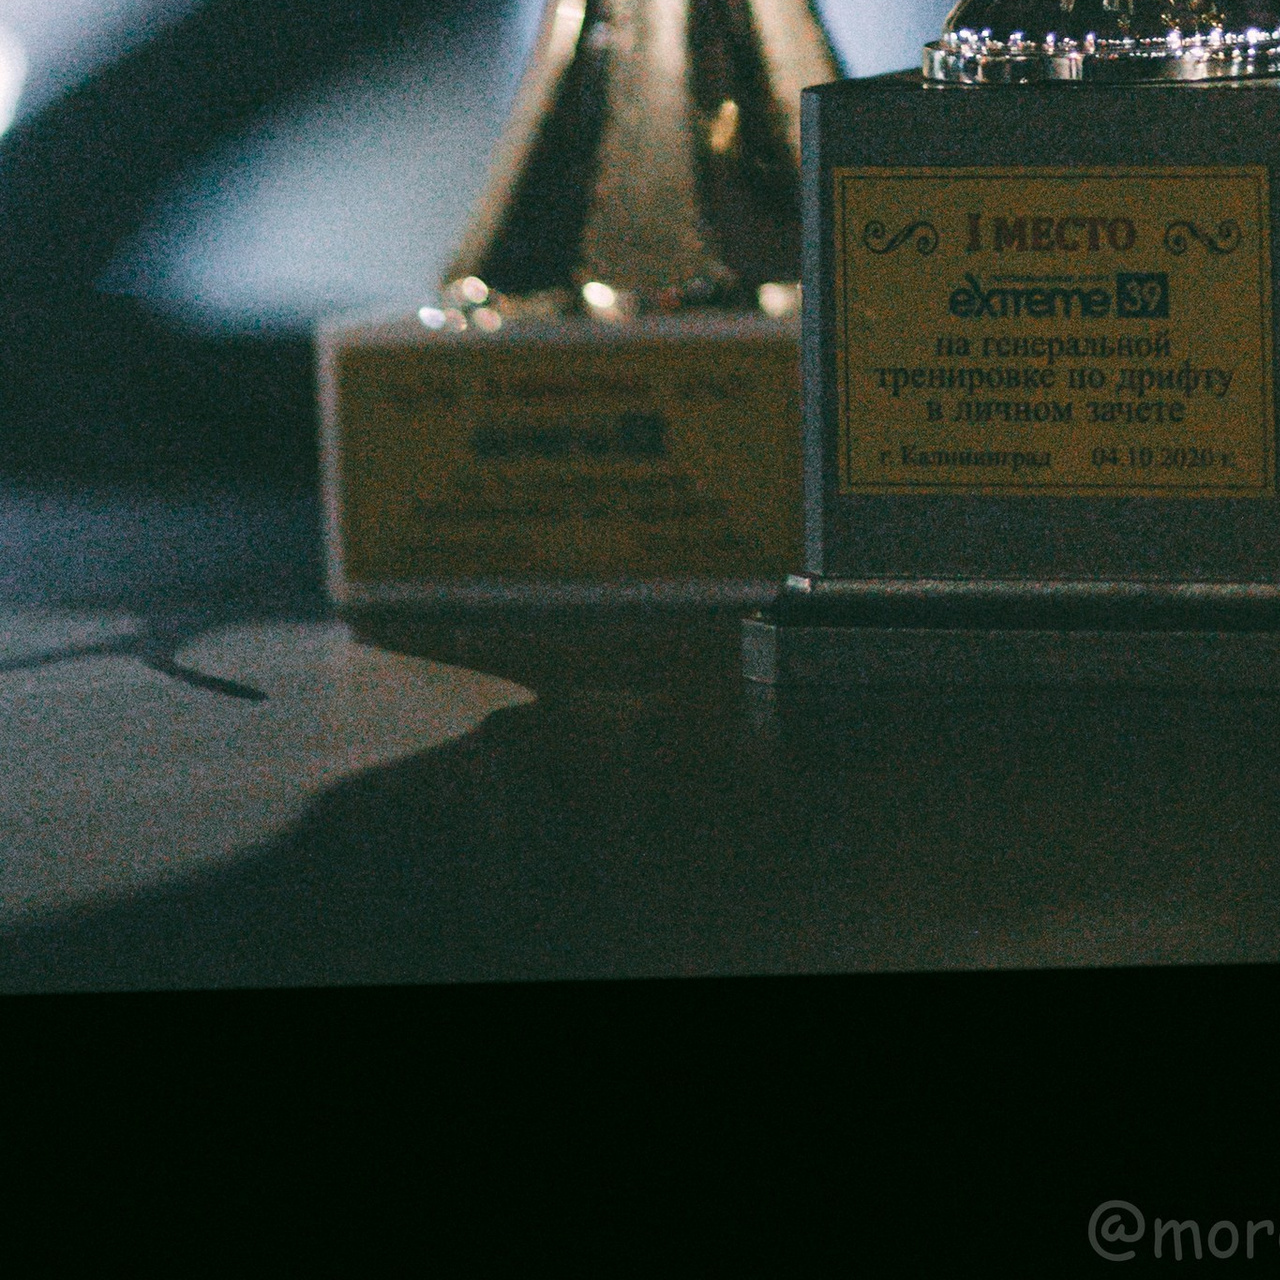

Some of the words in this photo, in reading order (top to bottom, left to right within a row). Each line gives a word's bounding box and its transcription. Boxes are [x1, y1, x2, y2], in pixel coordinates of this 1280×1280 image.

[993, 215, 1137, 252] МЕСТО
[935, 336, 970, 357] на
[982, 330, 1171, 364] генеральной
[874, 366, 1055, 396] тренировке
[1067, 368, 1106, 390] по
[1116, 360, 1234, 397] дрифту
[926, 401, 942, 422] в
[953, 399, 1073, 422] личном
[1086, 399, 1186, 422] зачете
